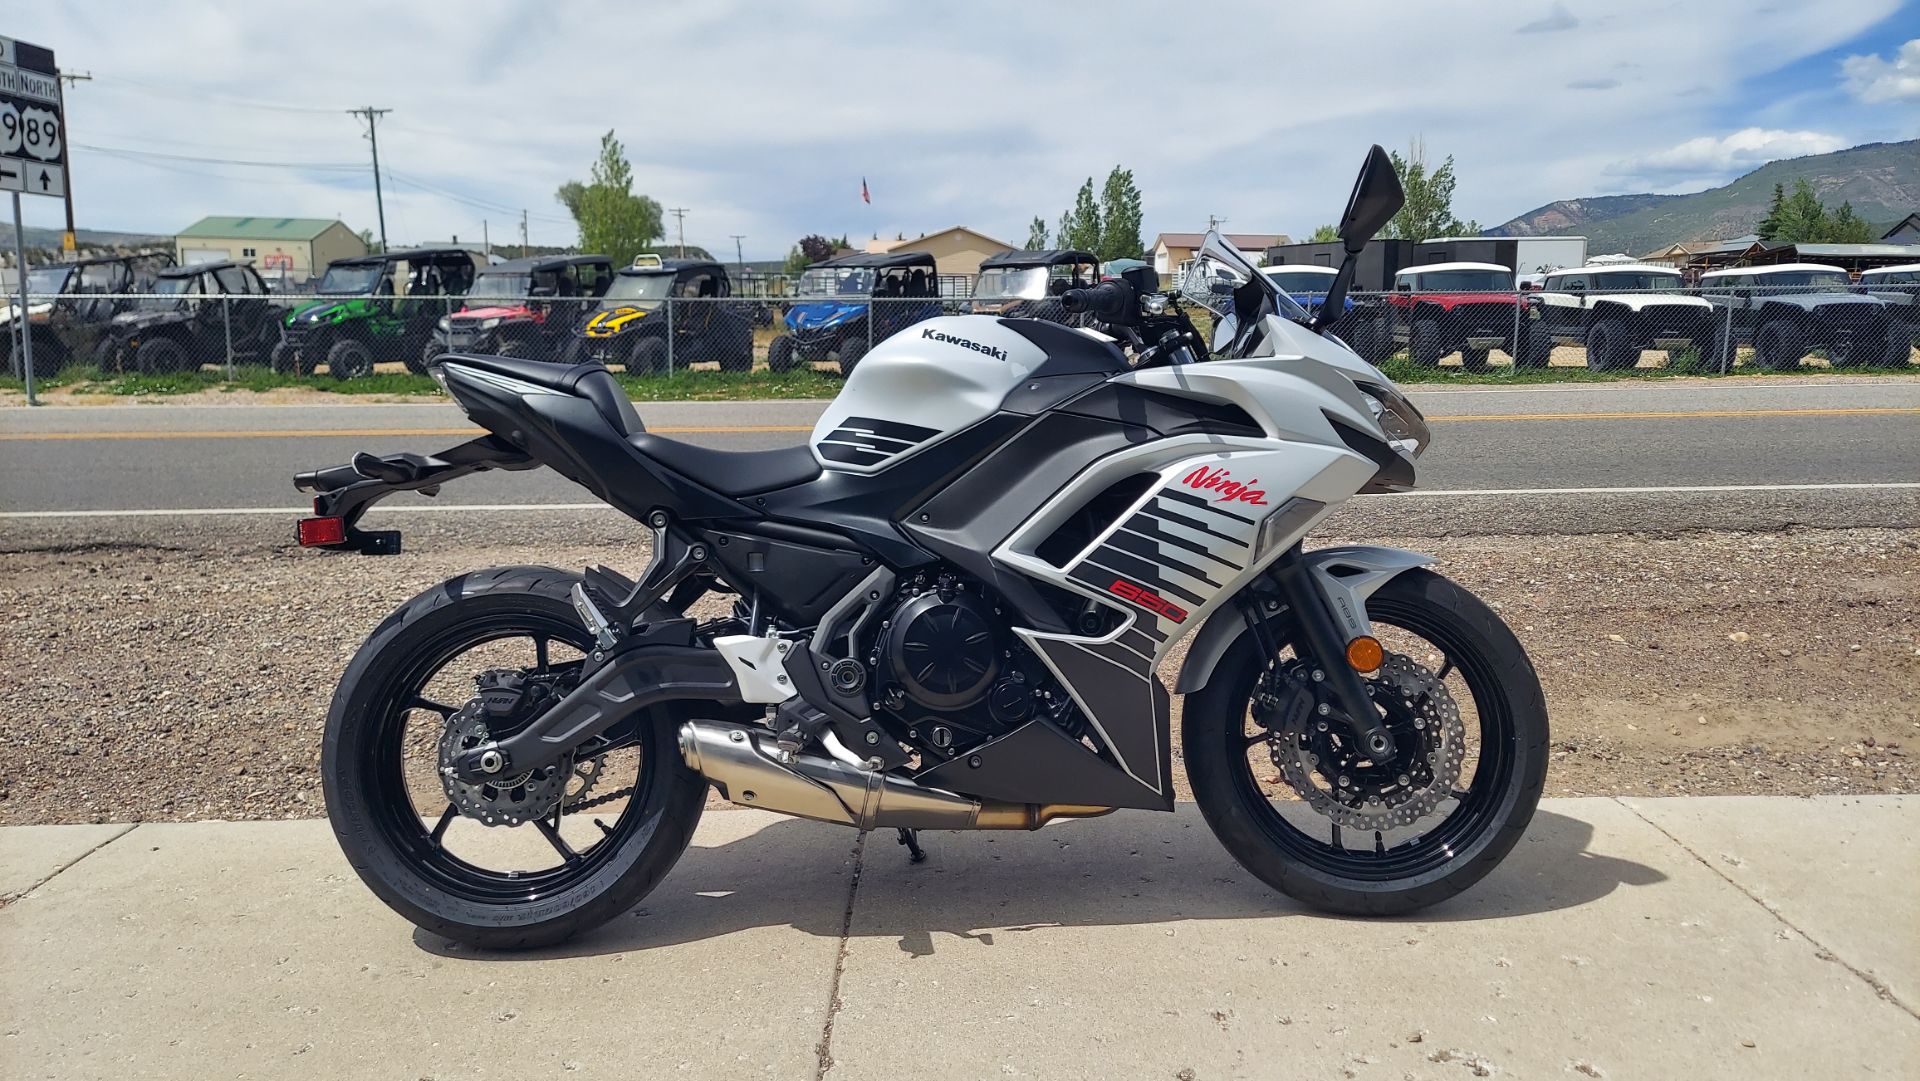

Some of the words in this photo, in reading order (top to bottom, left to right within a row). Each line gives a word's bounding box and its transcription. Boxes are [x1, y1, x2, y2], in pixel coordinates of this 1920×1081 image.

[20, 74, 57, 98] NORTH
[27, 118, 56, 148] 89
[922, 328, 1008, 362] Kawasaki
[1182, 465, 1268, 505] Ninja
[1109, 579, 1189, 623] 650
[1337, 596, 1357, 629] ABS
